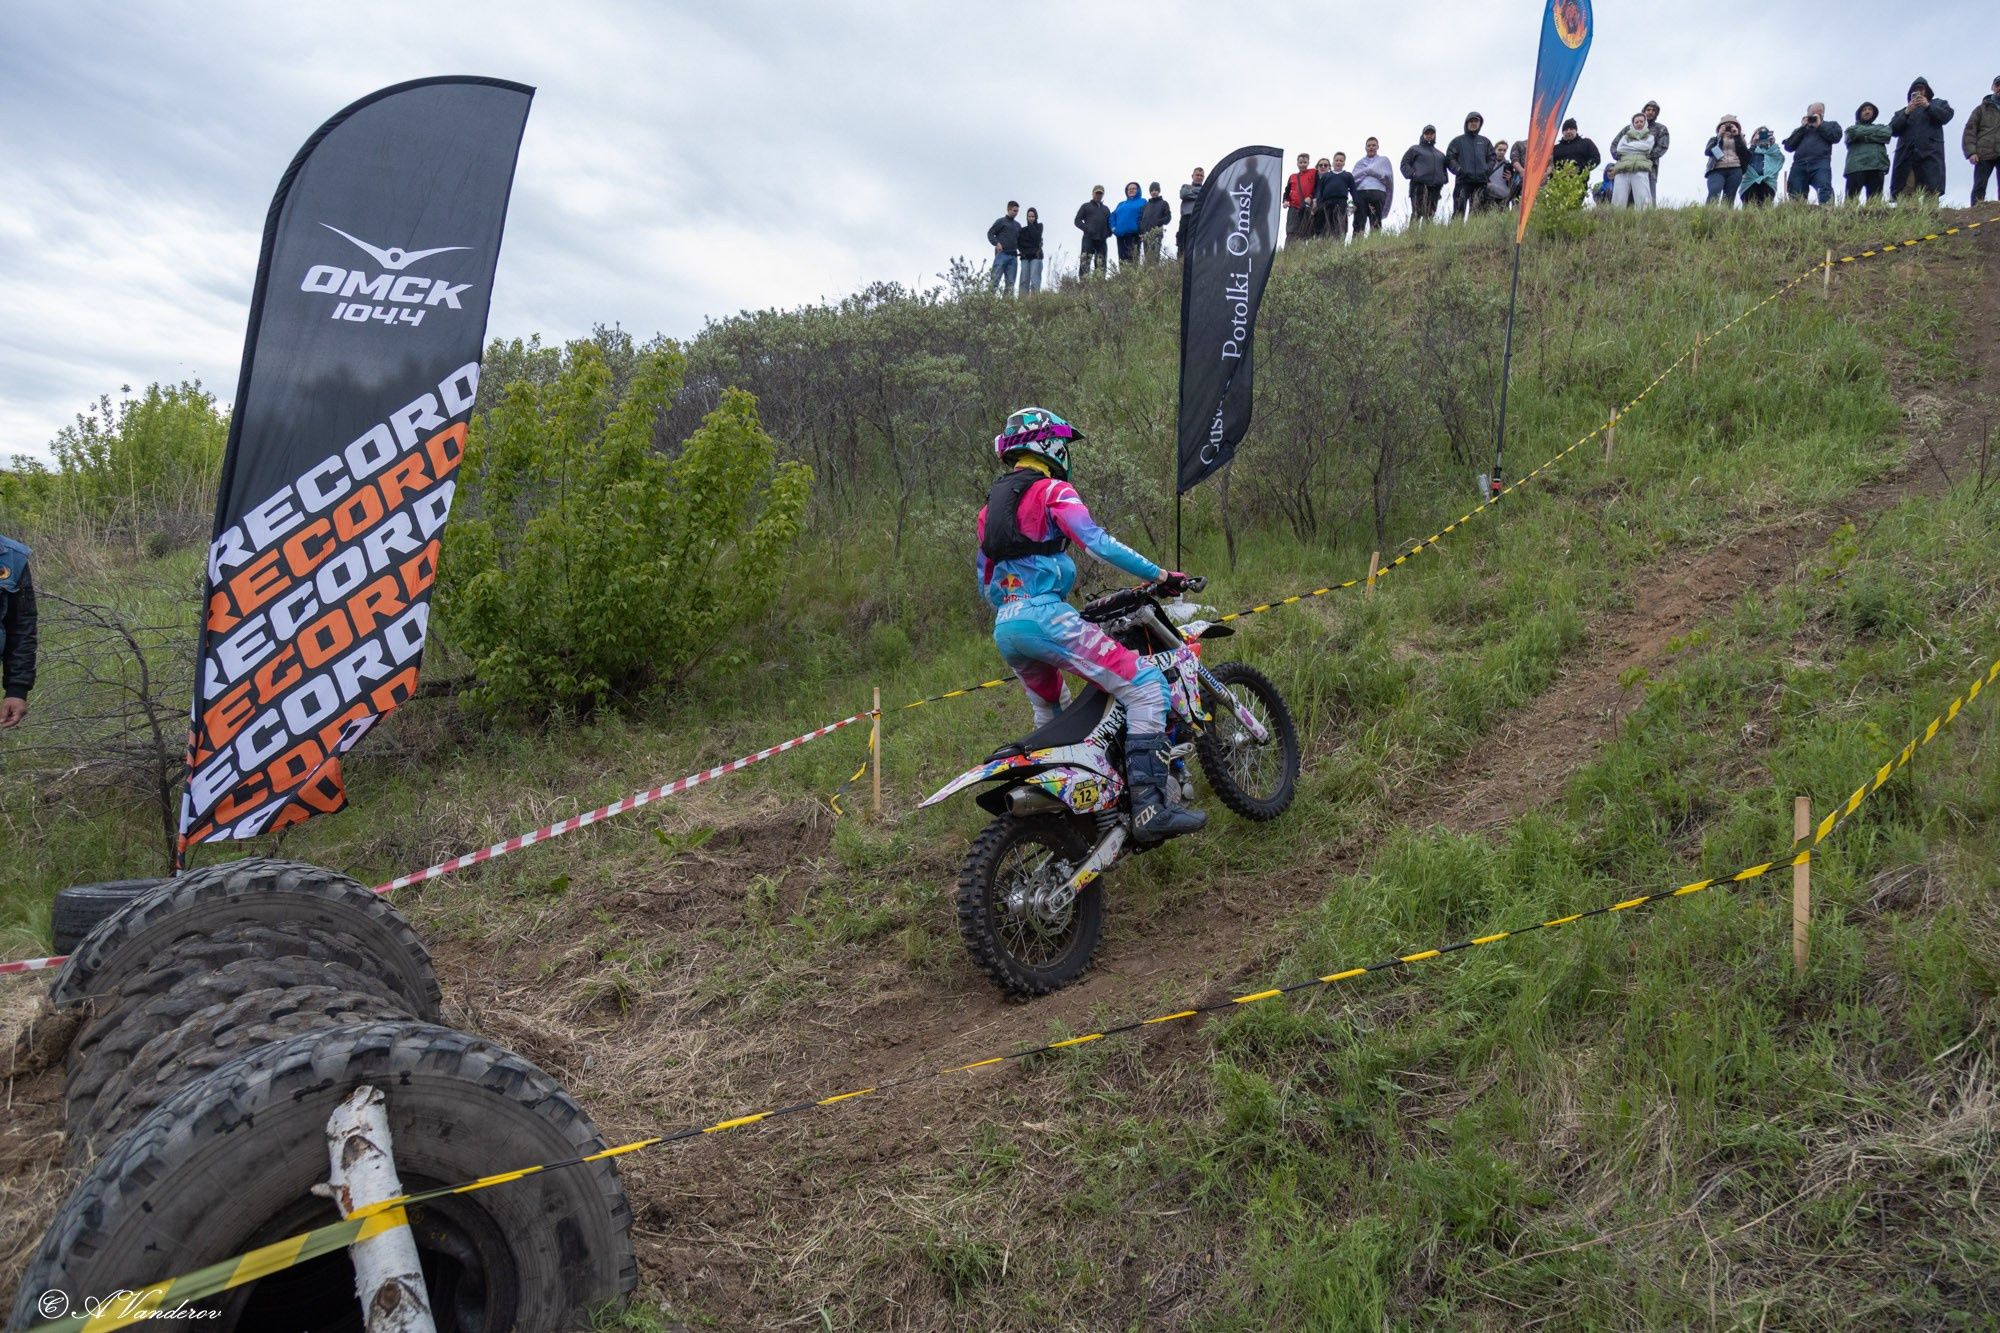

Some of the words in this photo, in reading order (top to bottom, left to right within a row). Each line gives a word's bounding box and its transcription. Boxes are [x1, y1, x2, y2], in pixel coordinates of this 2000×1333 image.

[331, 302, 426, 326] 104.4
[207, 422, 469, 634] RECORD
[208, 361, 481, 587] RECORD
[187, 602, 430, 827] ECORD
[1080, 789, 1092, 804] 12
[1134, 804, 1158, 828] FOX
